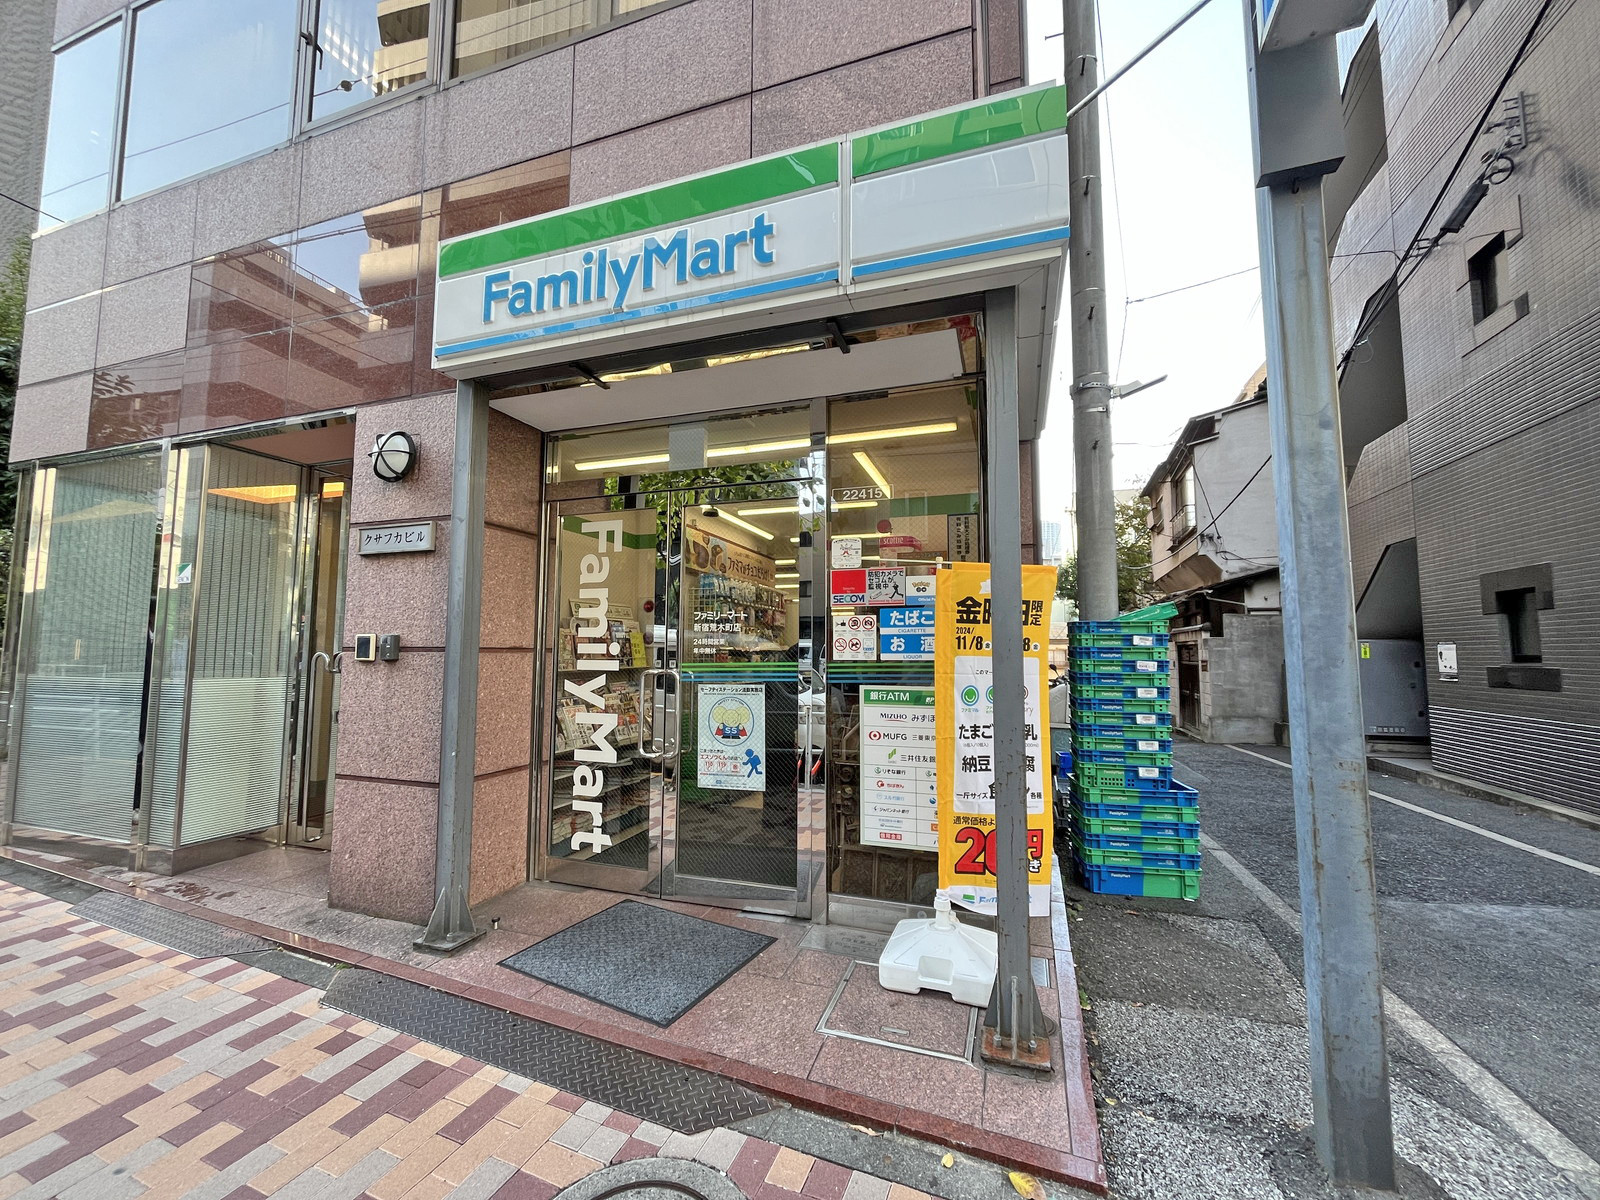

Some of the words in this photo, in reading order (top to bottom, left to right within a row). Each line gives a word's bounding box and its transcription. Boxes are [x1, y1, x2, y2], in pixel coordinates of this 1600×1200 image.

[482, 212, 776, 324] FamilyMart
[842, 487, 883, 501] 22415
[364, 530, 426, 547] クサフカビル
[868, 570, 904, 578] 防犯カメラで
[833, 595, 865, 603] SECOM
[693, 609, 748, 620] ファミリーマート
[889, 610, 935, 626] たばこ
[694, 623, 742, 632] 新宿荒木町店
[564, 519, 623, 854] FamilyMart
[870, 691, 910, 701] 銀行ATM
[883, 733, 908, 741] MUFG
[958, 724, 994, 740] たまご
[961, 755, 992, 773] 納豆
